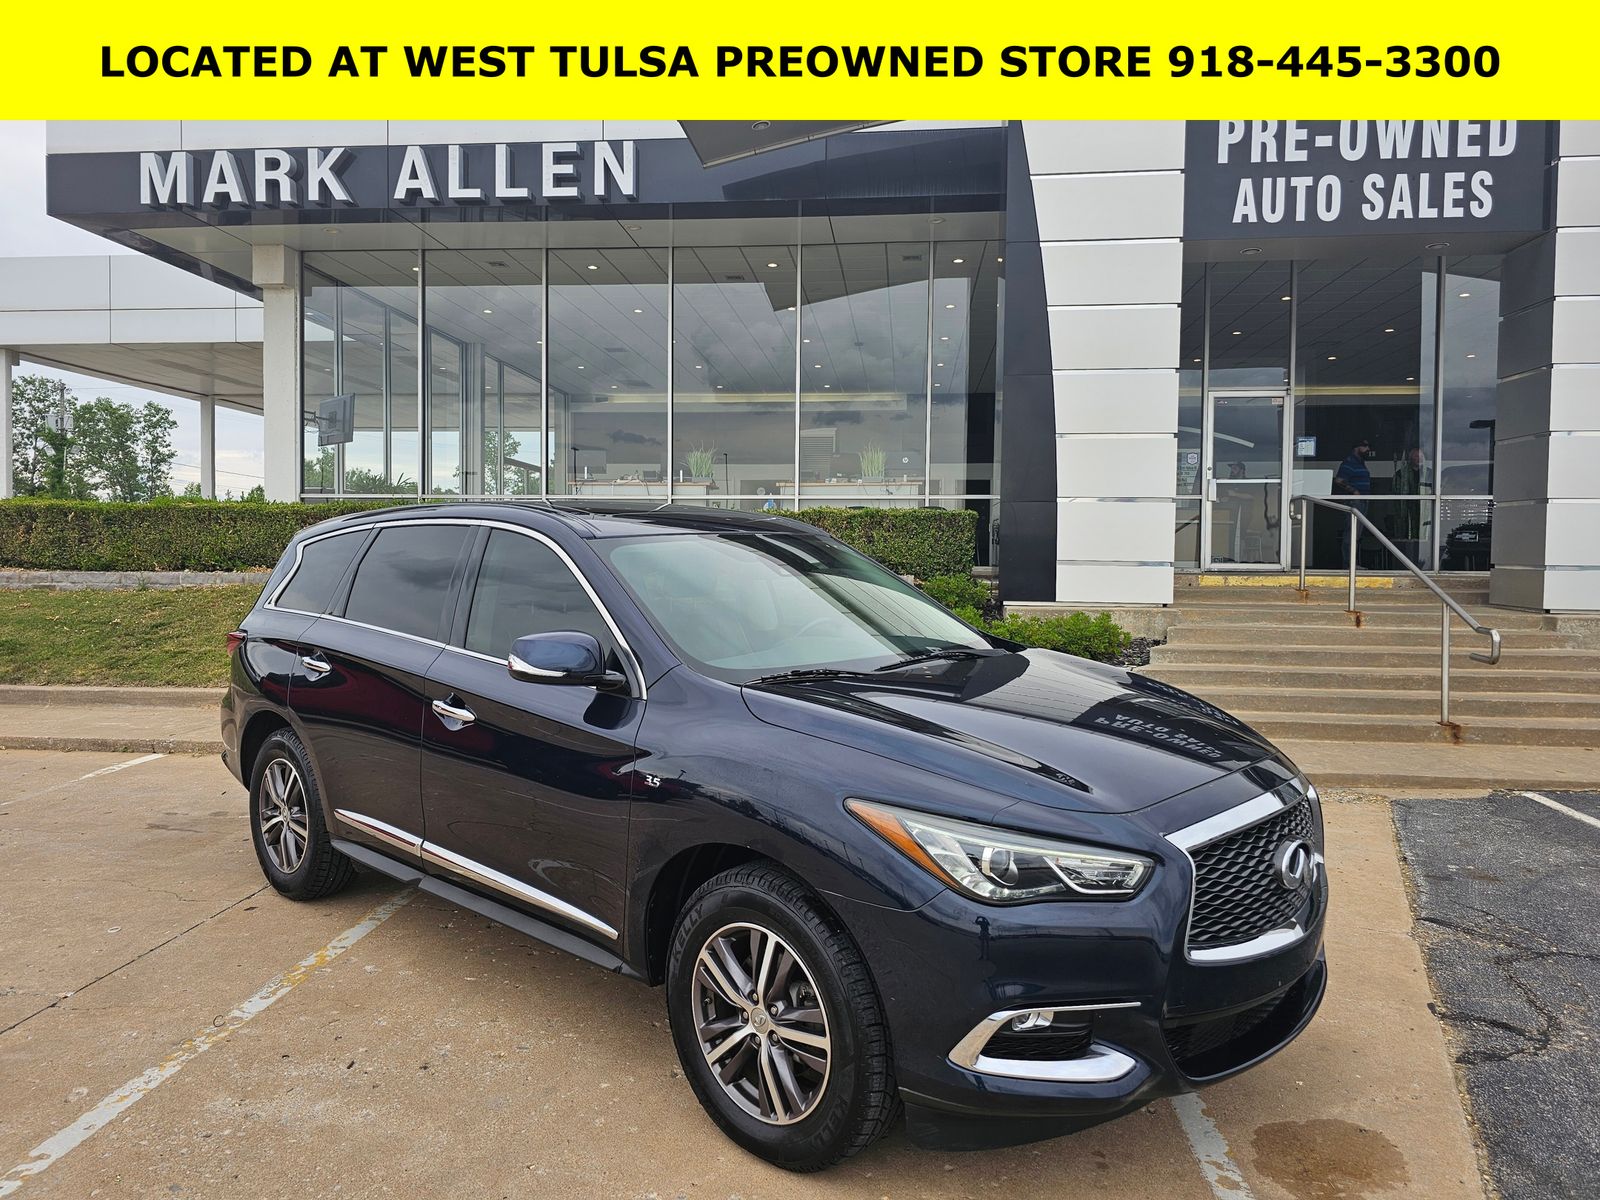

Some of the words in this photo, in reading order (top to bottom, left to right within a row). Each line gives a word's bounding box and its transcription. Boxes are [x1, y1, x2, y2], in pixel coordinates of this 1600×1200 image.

[1217, 119, 1518, 164] PRE-OWNED
[139, 146, 355, 206] MARK
[393, 140, 638, 202] ALLEN
[1232, 174, 1342, 224] AUTO
[1361, 170, 1494, 221] SALES
[673, 903, 704, 963] KELLY
